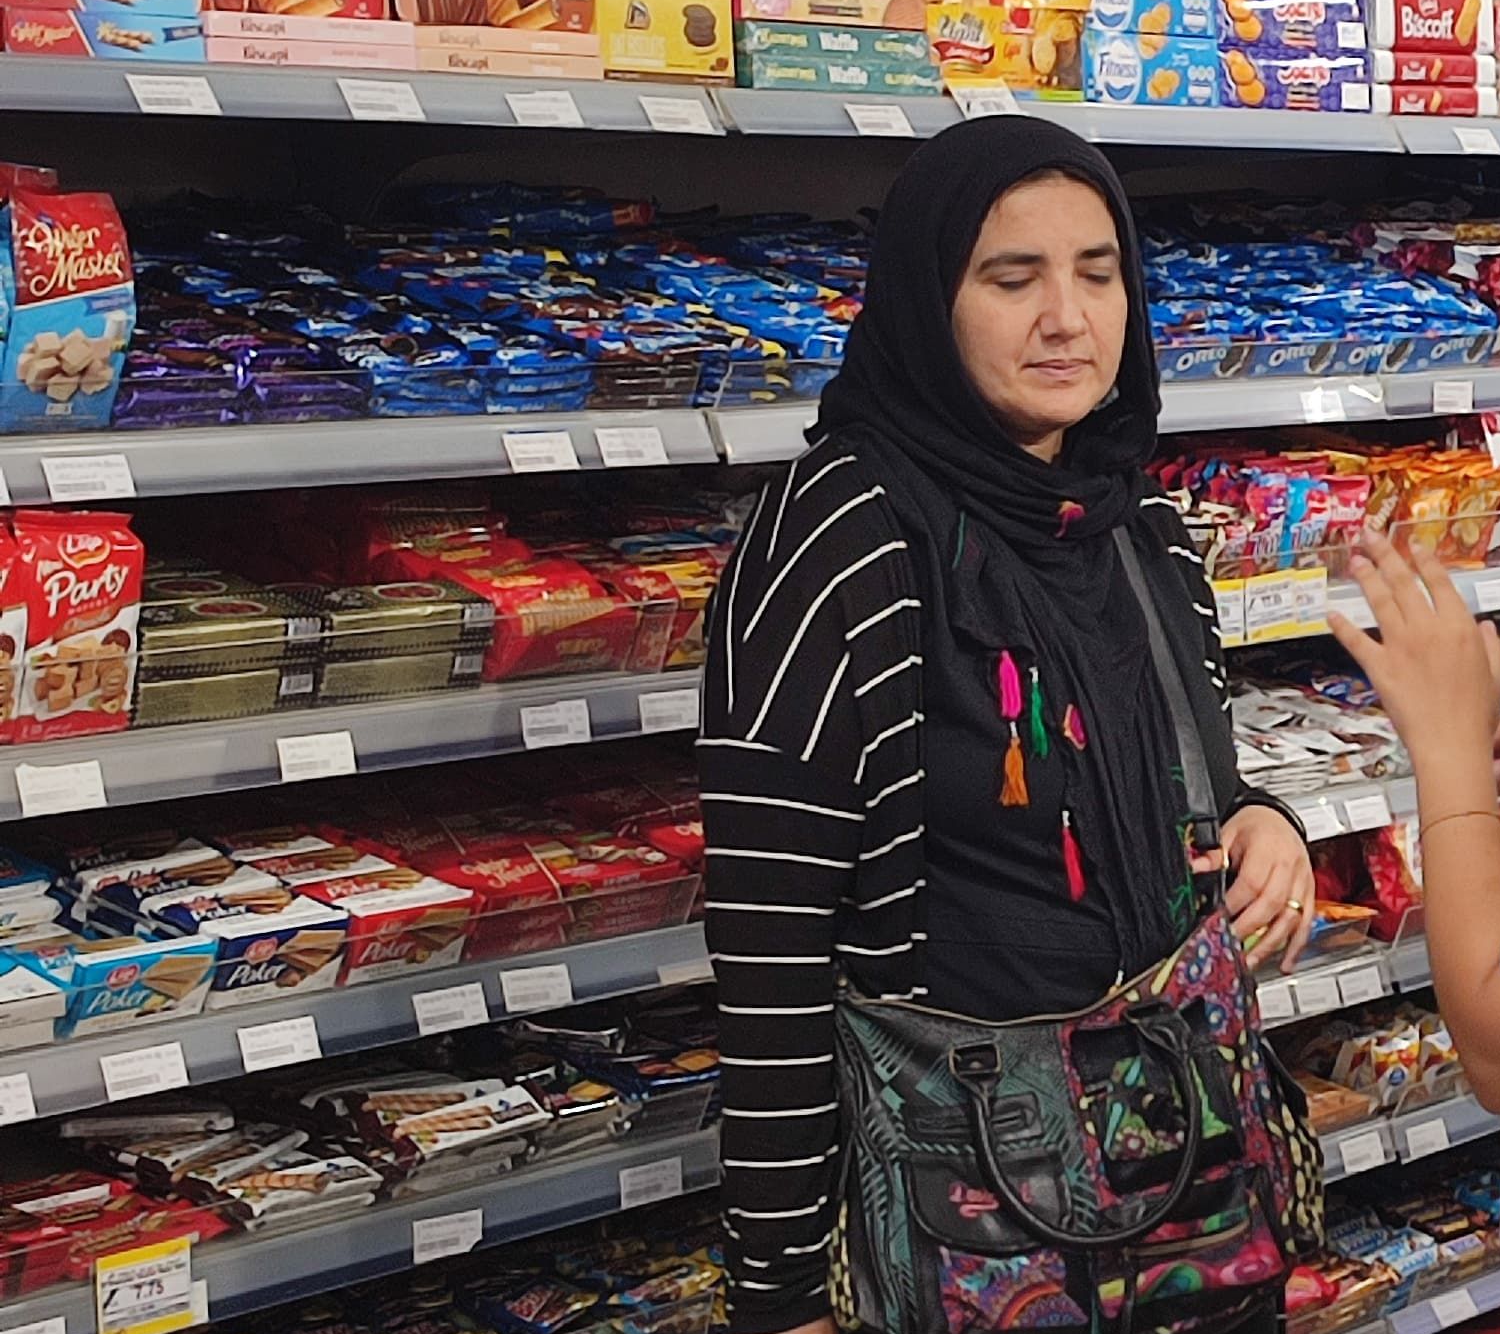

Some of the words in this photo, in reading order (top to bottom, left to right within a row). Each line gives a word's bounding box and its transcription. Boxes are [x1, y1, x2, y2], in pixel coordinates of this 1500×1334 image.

[1401, 5, 1455, 41] Biscoff
[30, 250, 125, 296] Master
[1176, 347, 1227, 372] OREO
[1269, 345, 1316, 368] OREO
[1430, 338, 1474, 360] OREO
[44, 564, 129, 618] Party
[134, 878, 190, 898] Poker
[327, 880, 381, 900] Poker
[360, 939, 412, 964] Poker
[227, 963, 288, 987] Poker
[87, 984, 151, 1014] Poker
